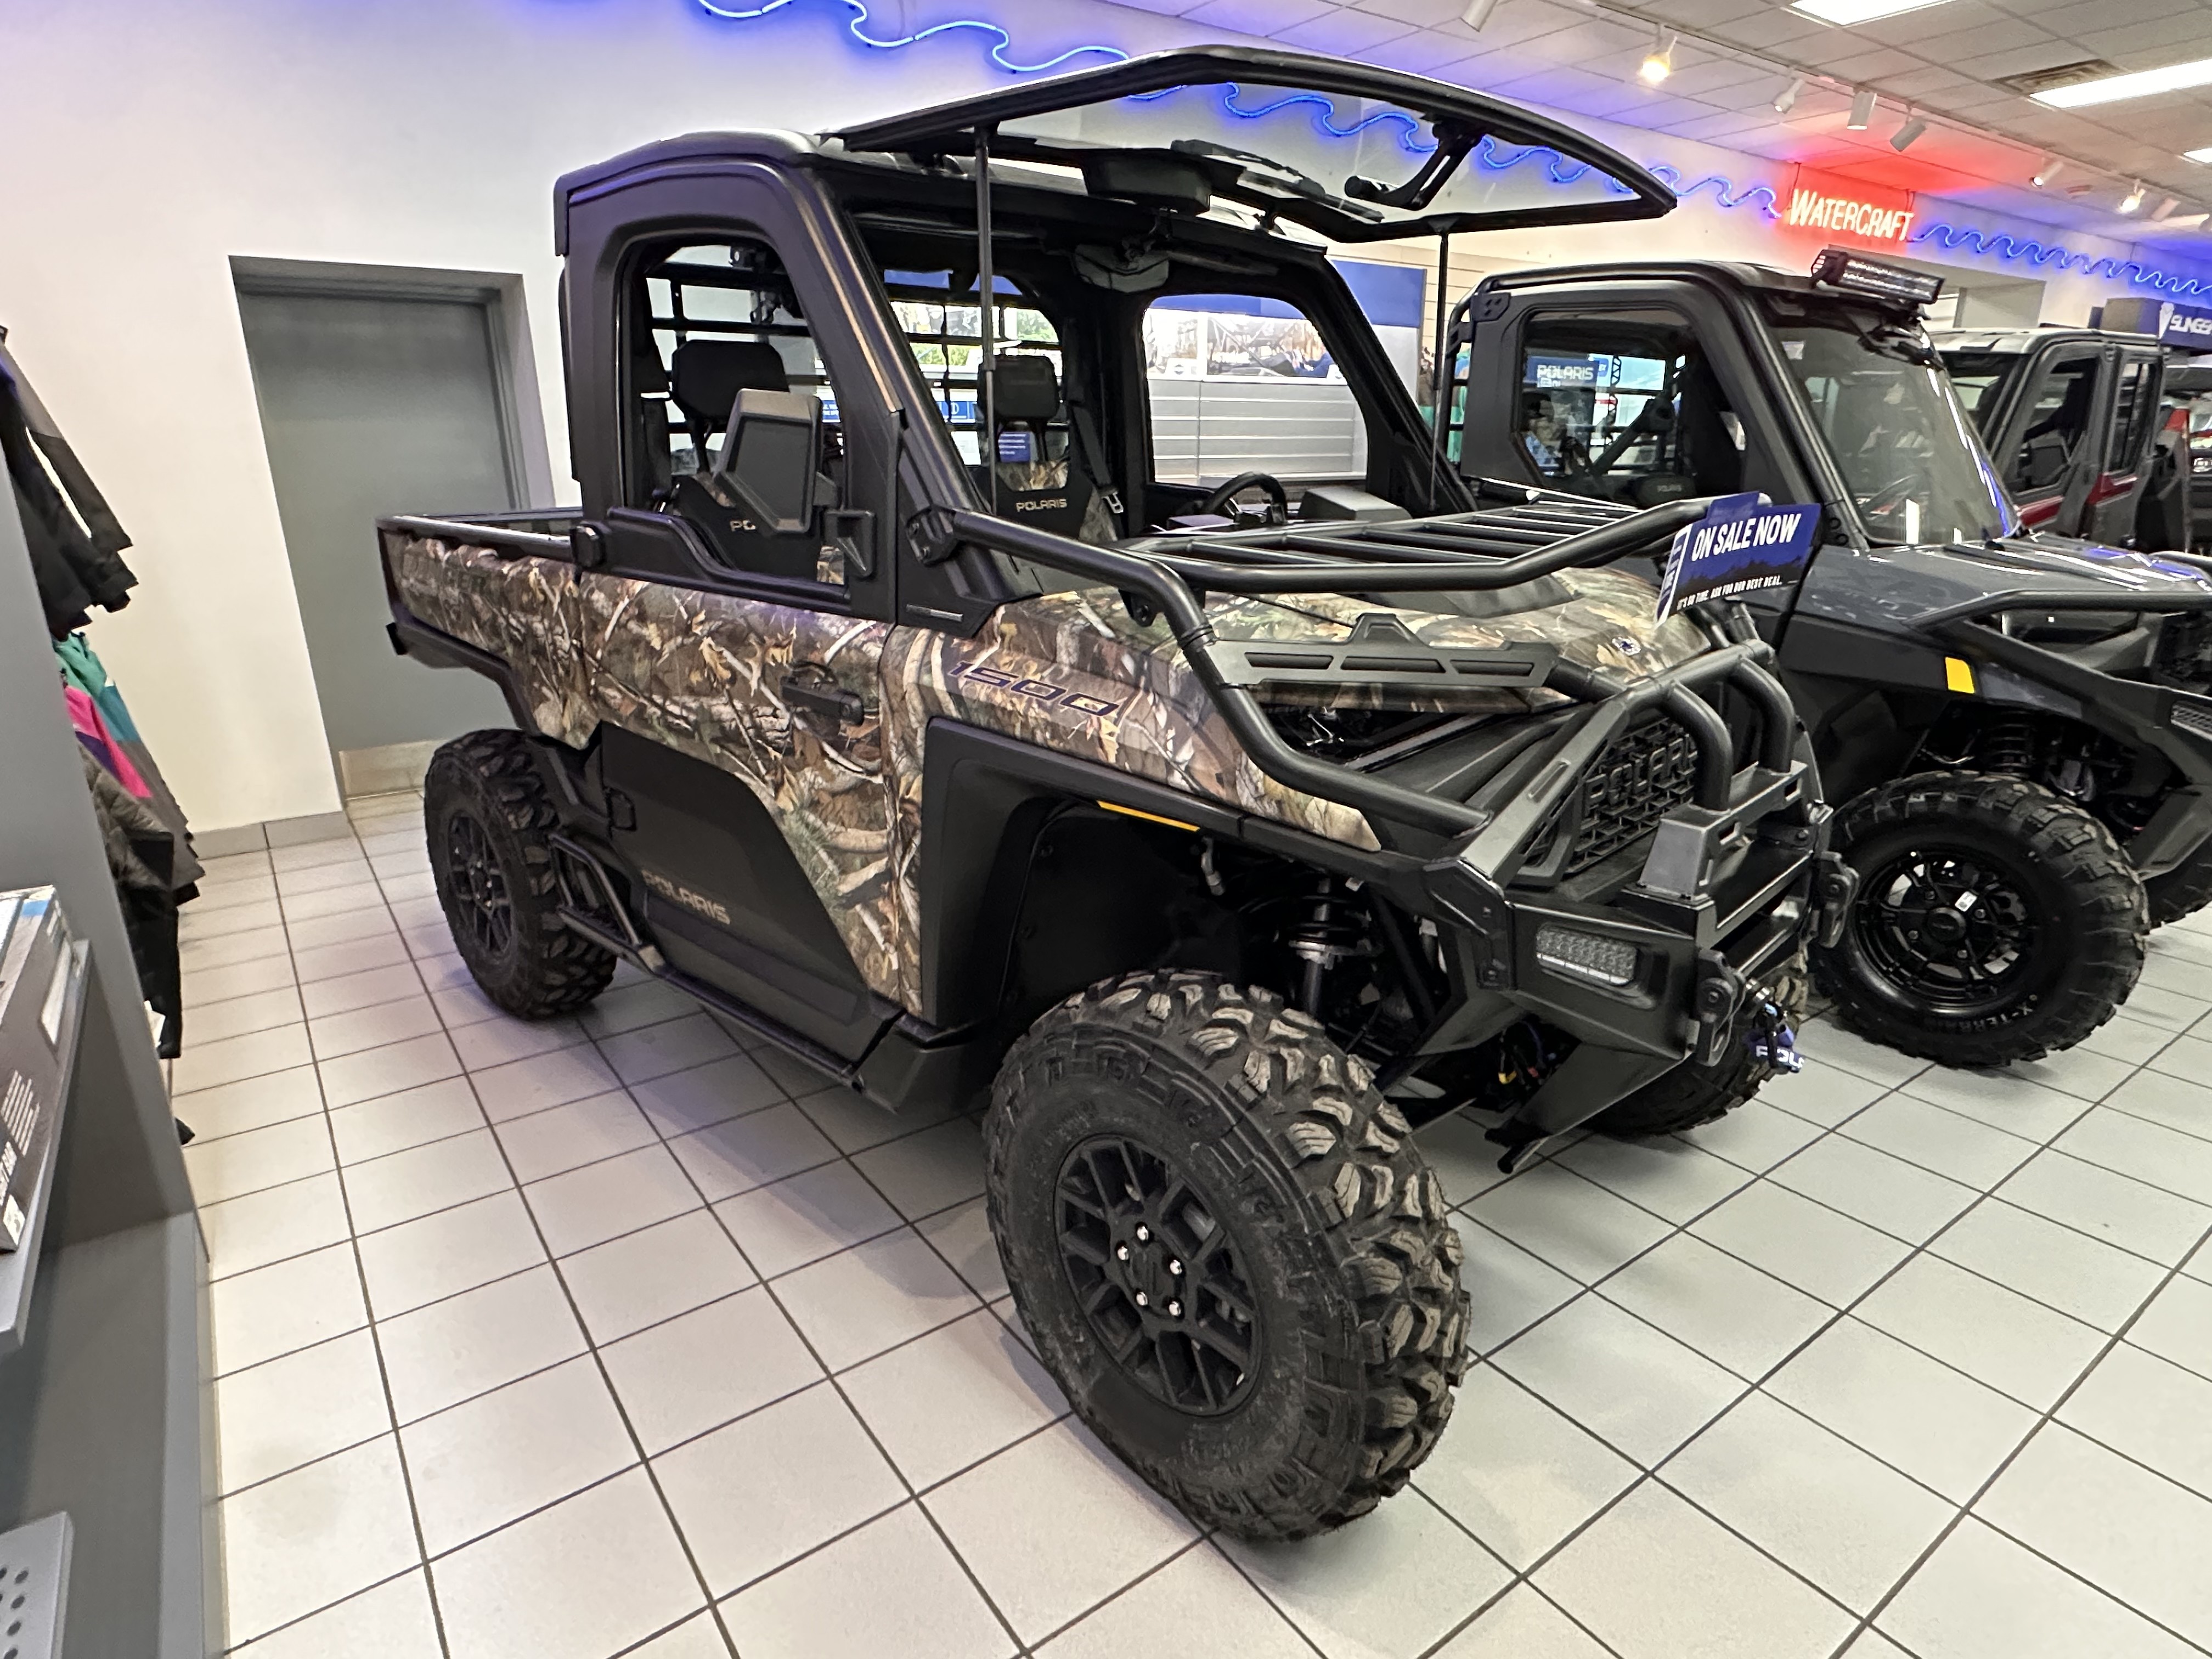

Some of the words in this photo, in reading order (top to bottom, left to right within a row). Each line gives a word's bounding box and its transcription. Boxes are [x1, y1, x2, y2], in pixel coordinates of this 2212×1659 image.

[1790, 189, 1914, 241] WATERCRAFT
[1537, 364, 1594, 380] POLARIS
[1016, 498, 1068, 512] POLARIS
[1691, 526, 1717, 562] ON
[1713, 517, 1756, 556] SALE
[1752, 513, 1802, 547] NOW
[1746, 577, 1763, 590] BEST
[947, 661, 1120, 716] 1500
[641, 869, 731, 925] POLARIS
